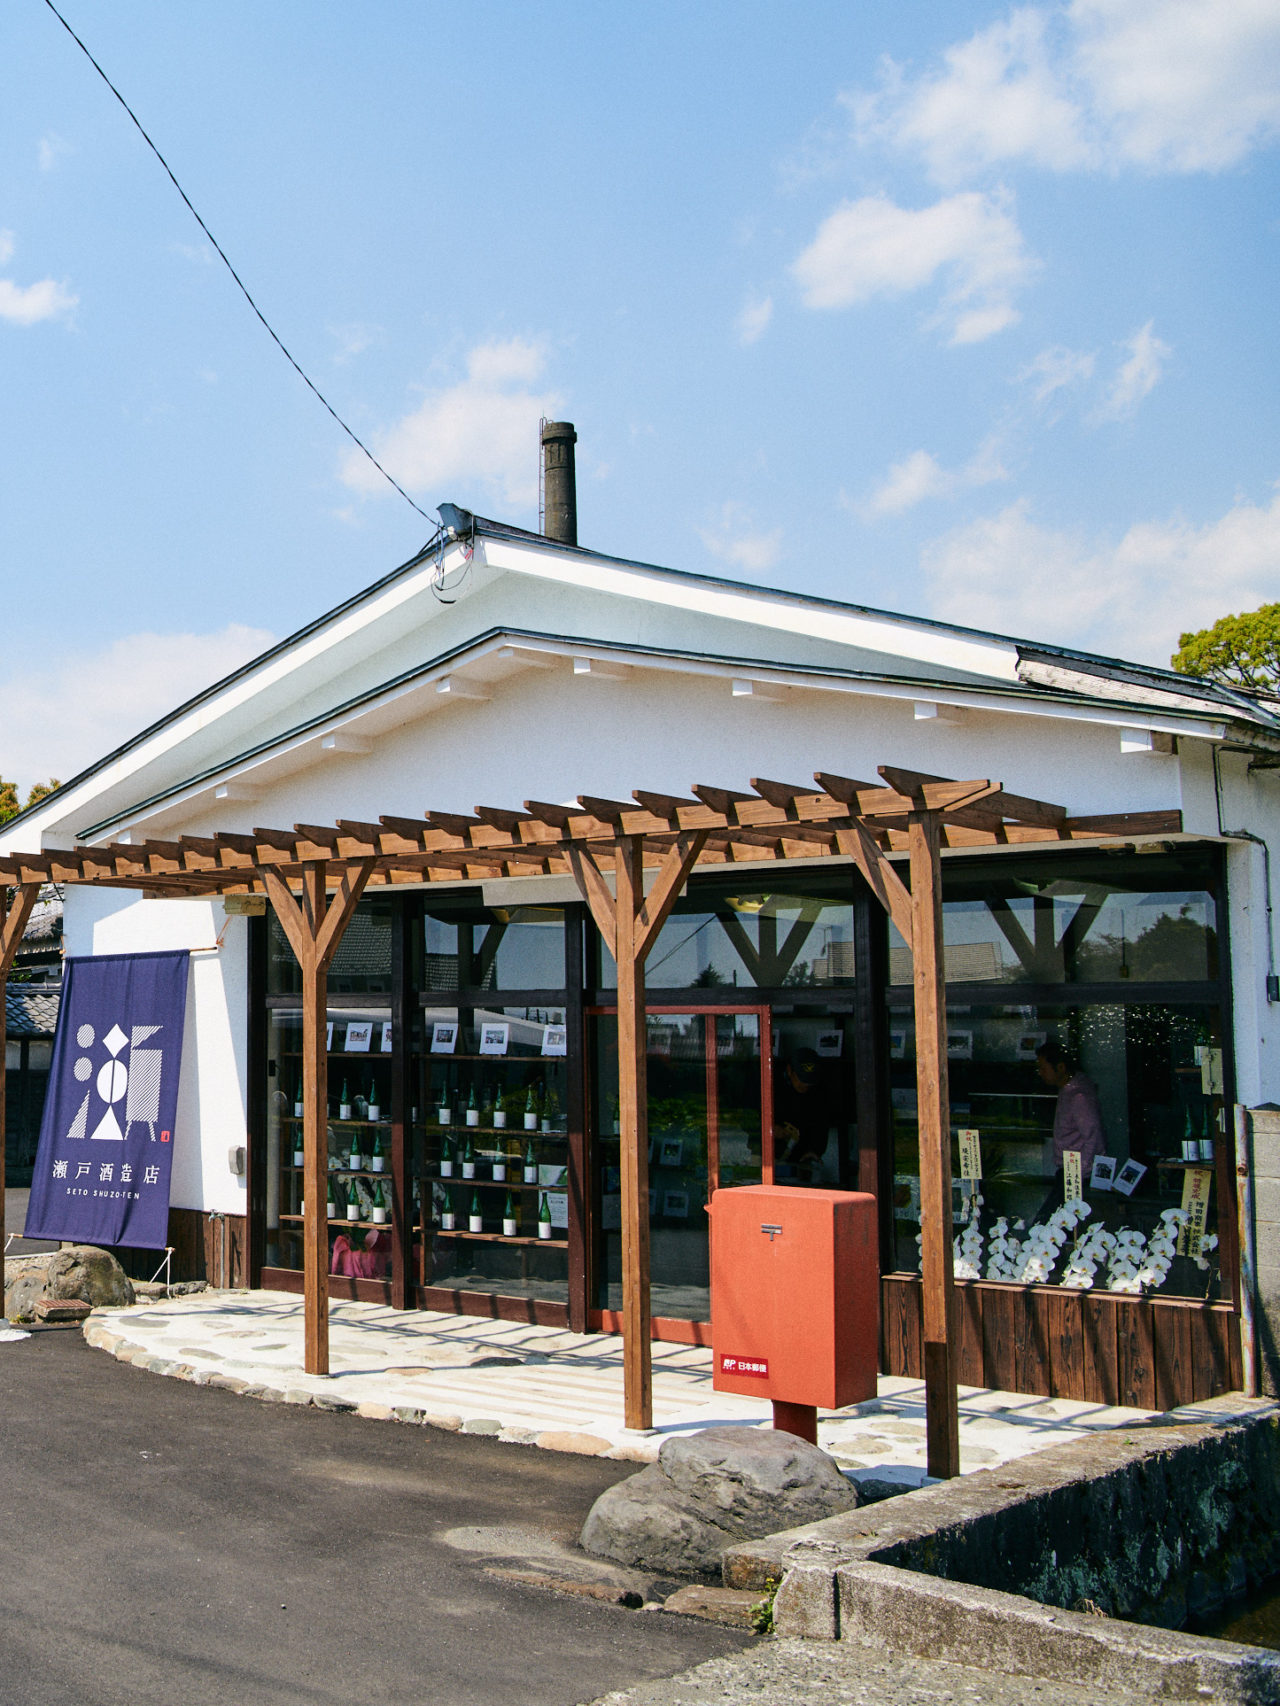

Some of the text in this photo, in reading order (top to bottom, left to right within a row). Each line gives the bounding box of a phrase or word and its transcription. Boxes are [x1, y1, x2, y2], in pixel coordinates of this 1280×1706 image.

[52, 1159, 160, 1184] 瀬戸酒造店
[66, 1187, 88, 1196] SETO
